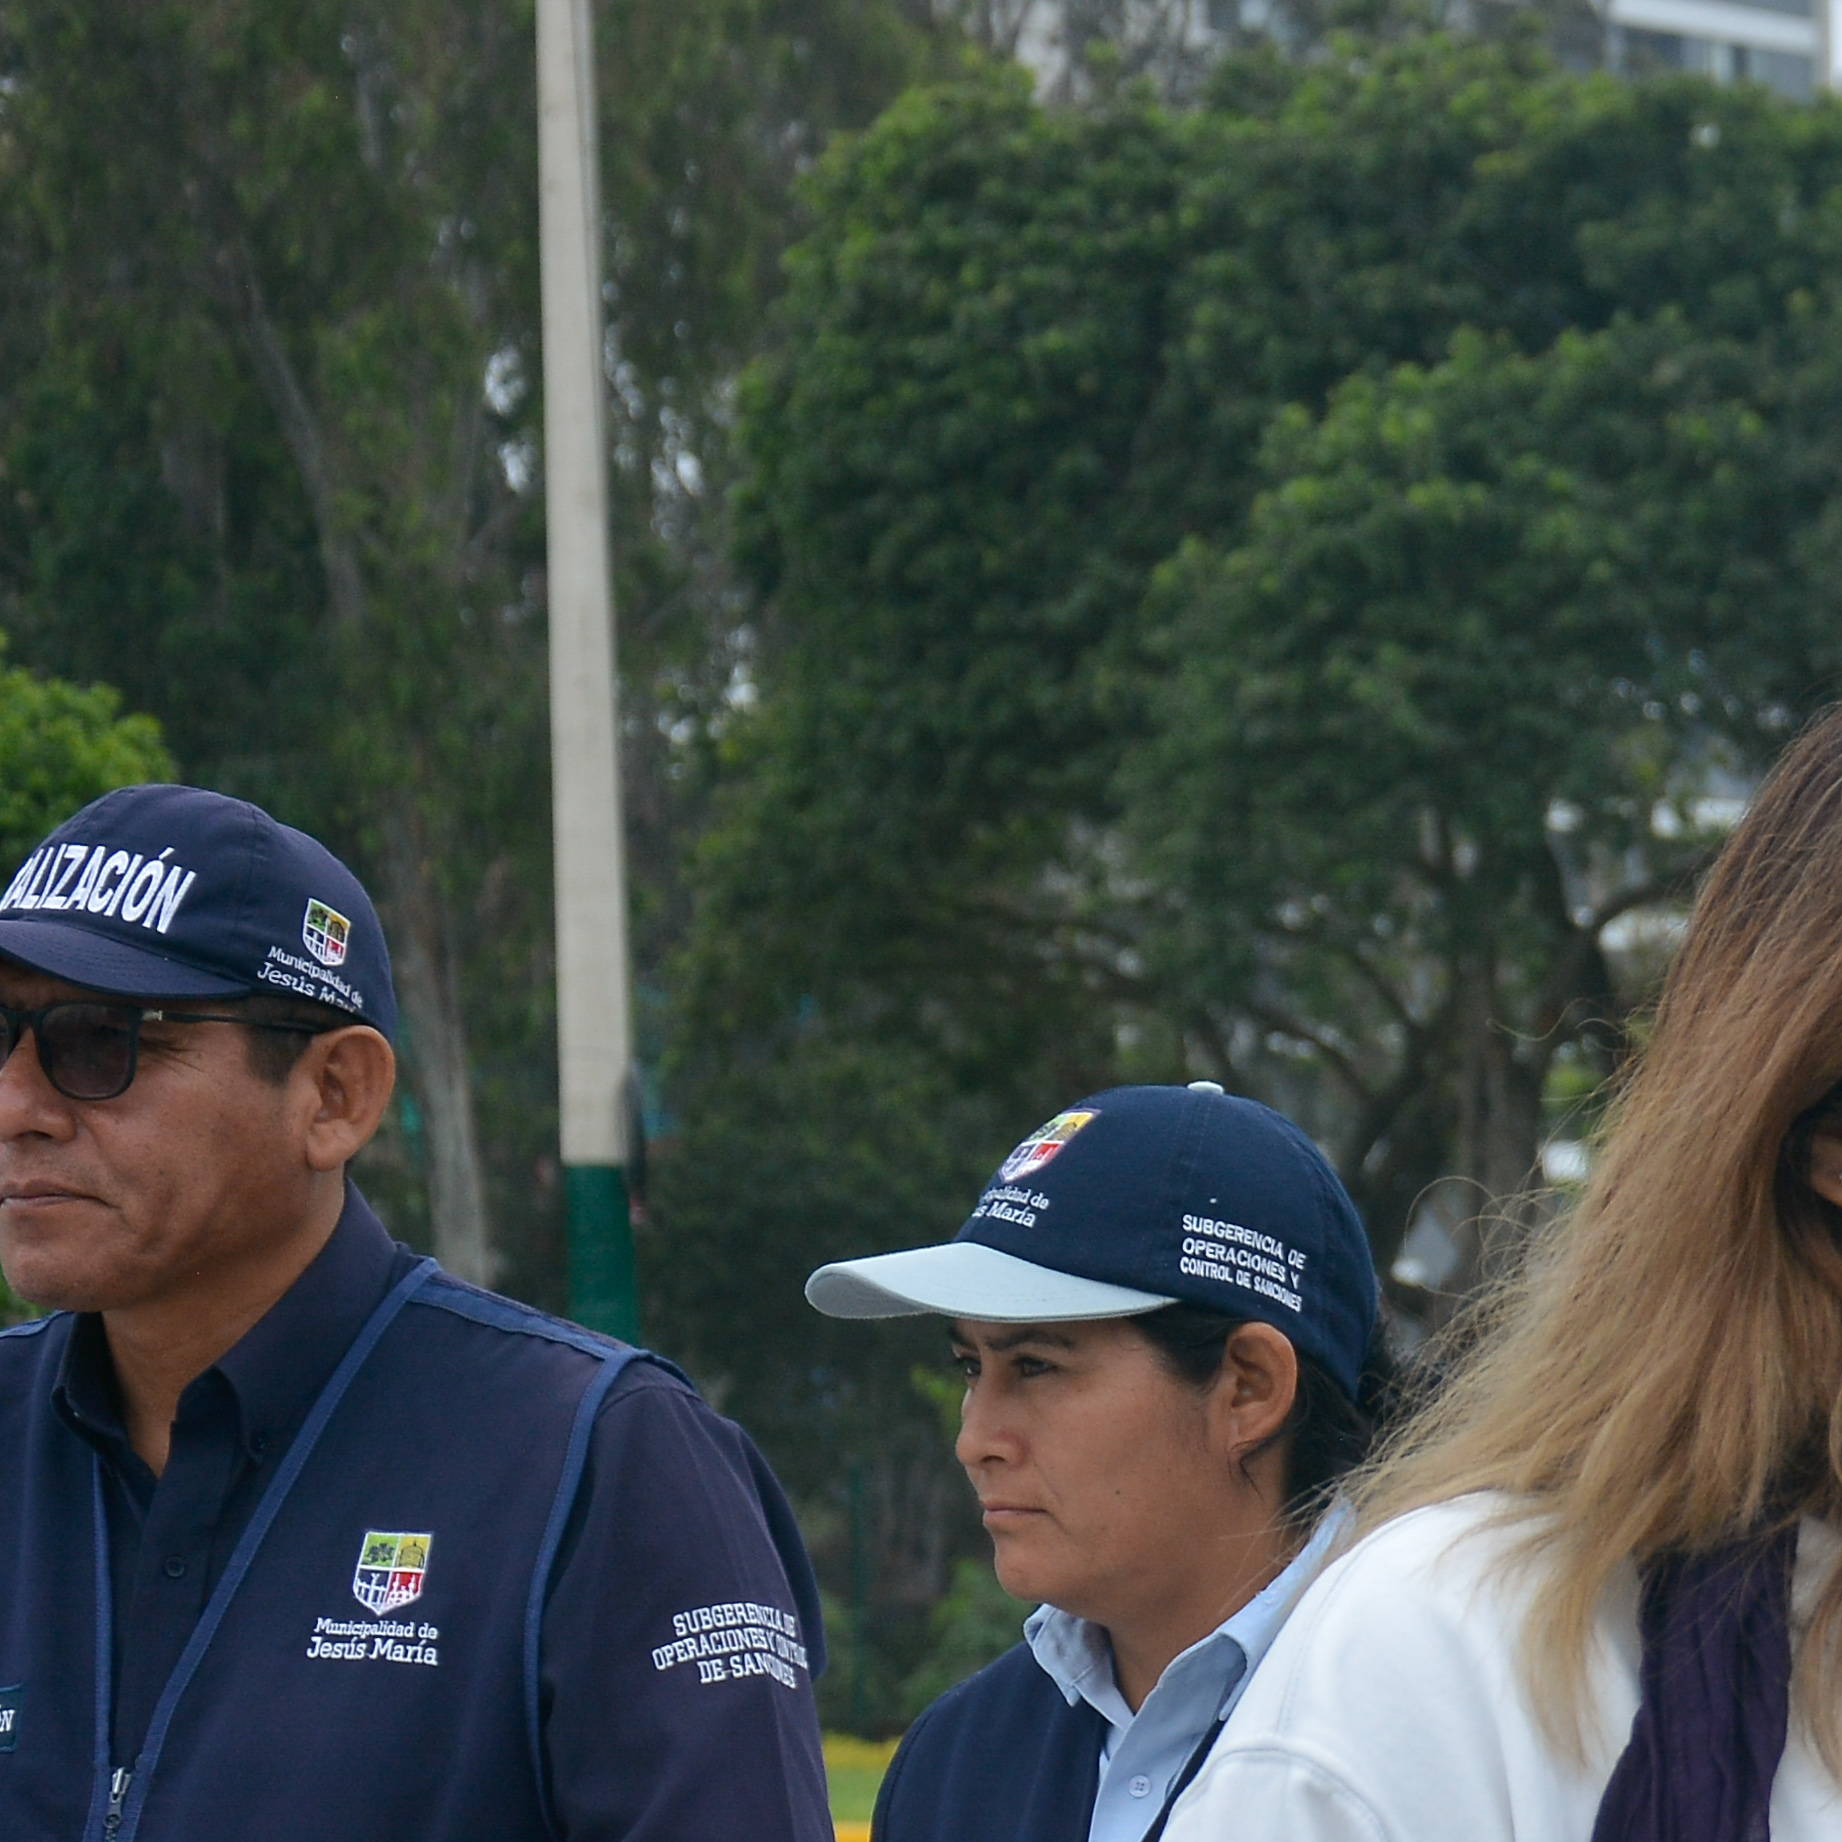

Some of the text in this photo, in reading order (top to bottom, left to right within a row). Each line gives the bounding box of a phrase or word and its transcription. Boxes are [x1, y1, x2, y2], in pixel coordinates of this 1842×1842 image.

[0, 843, 197, 934] ALIZACIÓN
[257, 961, 316, 998] Jesús
[986, 1200, 1036, 1229] María
[1030, 1191, 1051, 1210] de
[1182, 1213, 1306, 1270] SUBGERENCIA DE
[1180, 1256, 1234, 1283] CONTROL
[1235, 1268, 1252, 1289] DE
[1182, 1237, 1300, 1290] OPERACIONES Y
[313, 1617, 439, 1640] Municipalidad de
[306, 1635, 439, 1666] Jesús María
[651, 1626, 768, 1671] OPERACIONES
[697, 1657, 727, 1685] DE
